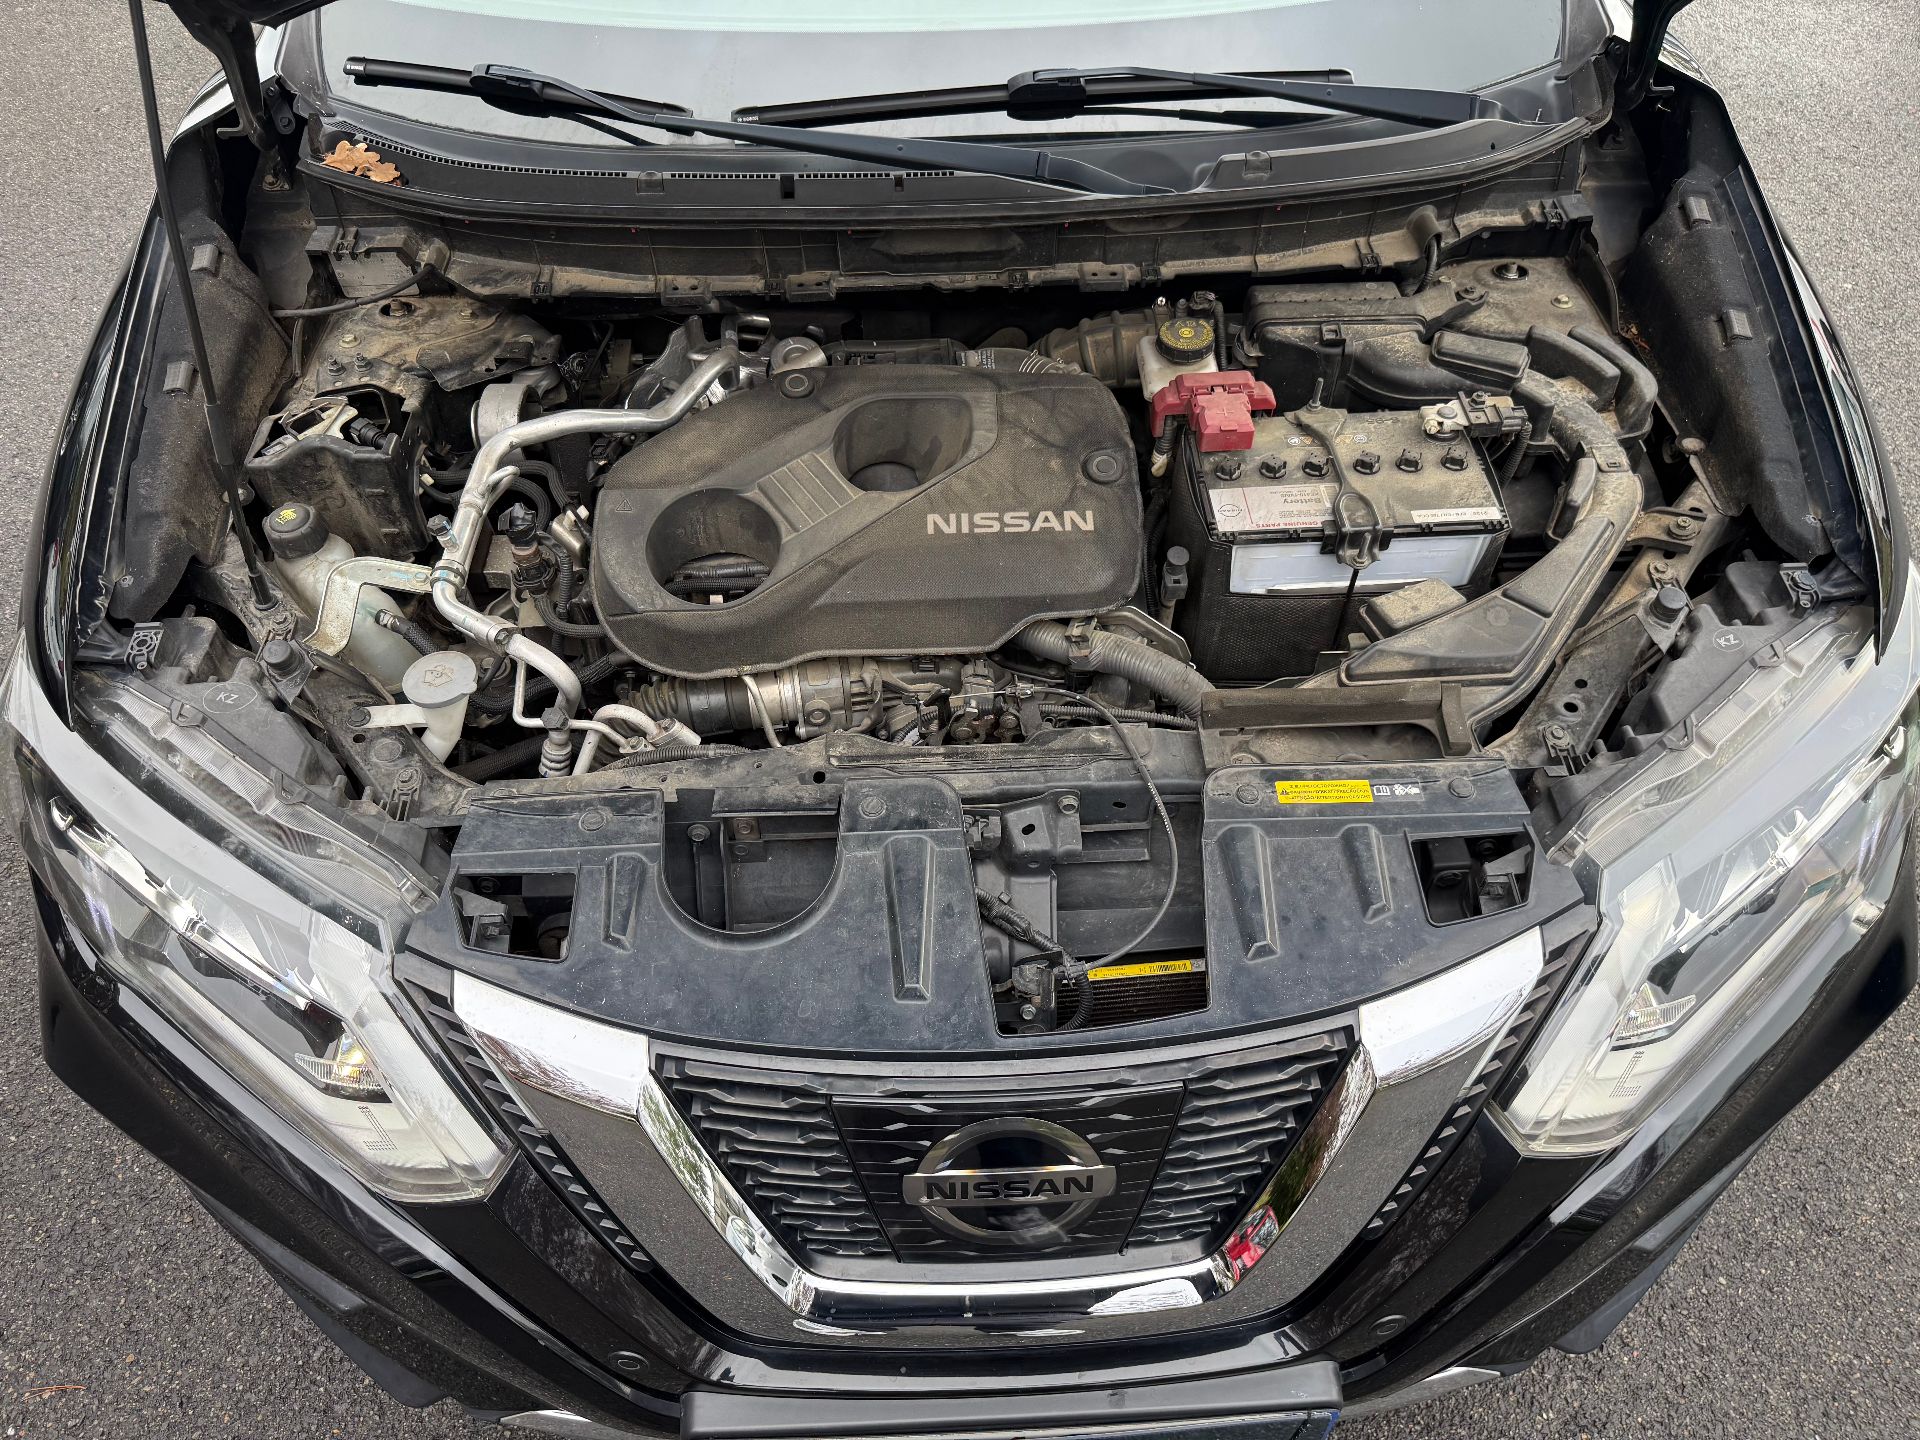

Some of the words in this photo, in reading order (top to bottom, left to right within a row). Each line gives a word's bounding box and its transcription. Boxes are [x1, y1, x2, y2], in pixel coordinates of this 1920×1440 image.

[1283, 497, 1321, 505] Battery
[926, 510, 1095, 535] NISSAN
[1715, 633, 1739, 647] KZ
[216, 691, 239, 704] KZ
[926, 1175, 1094, 1200] NISSAN
